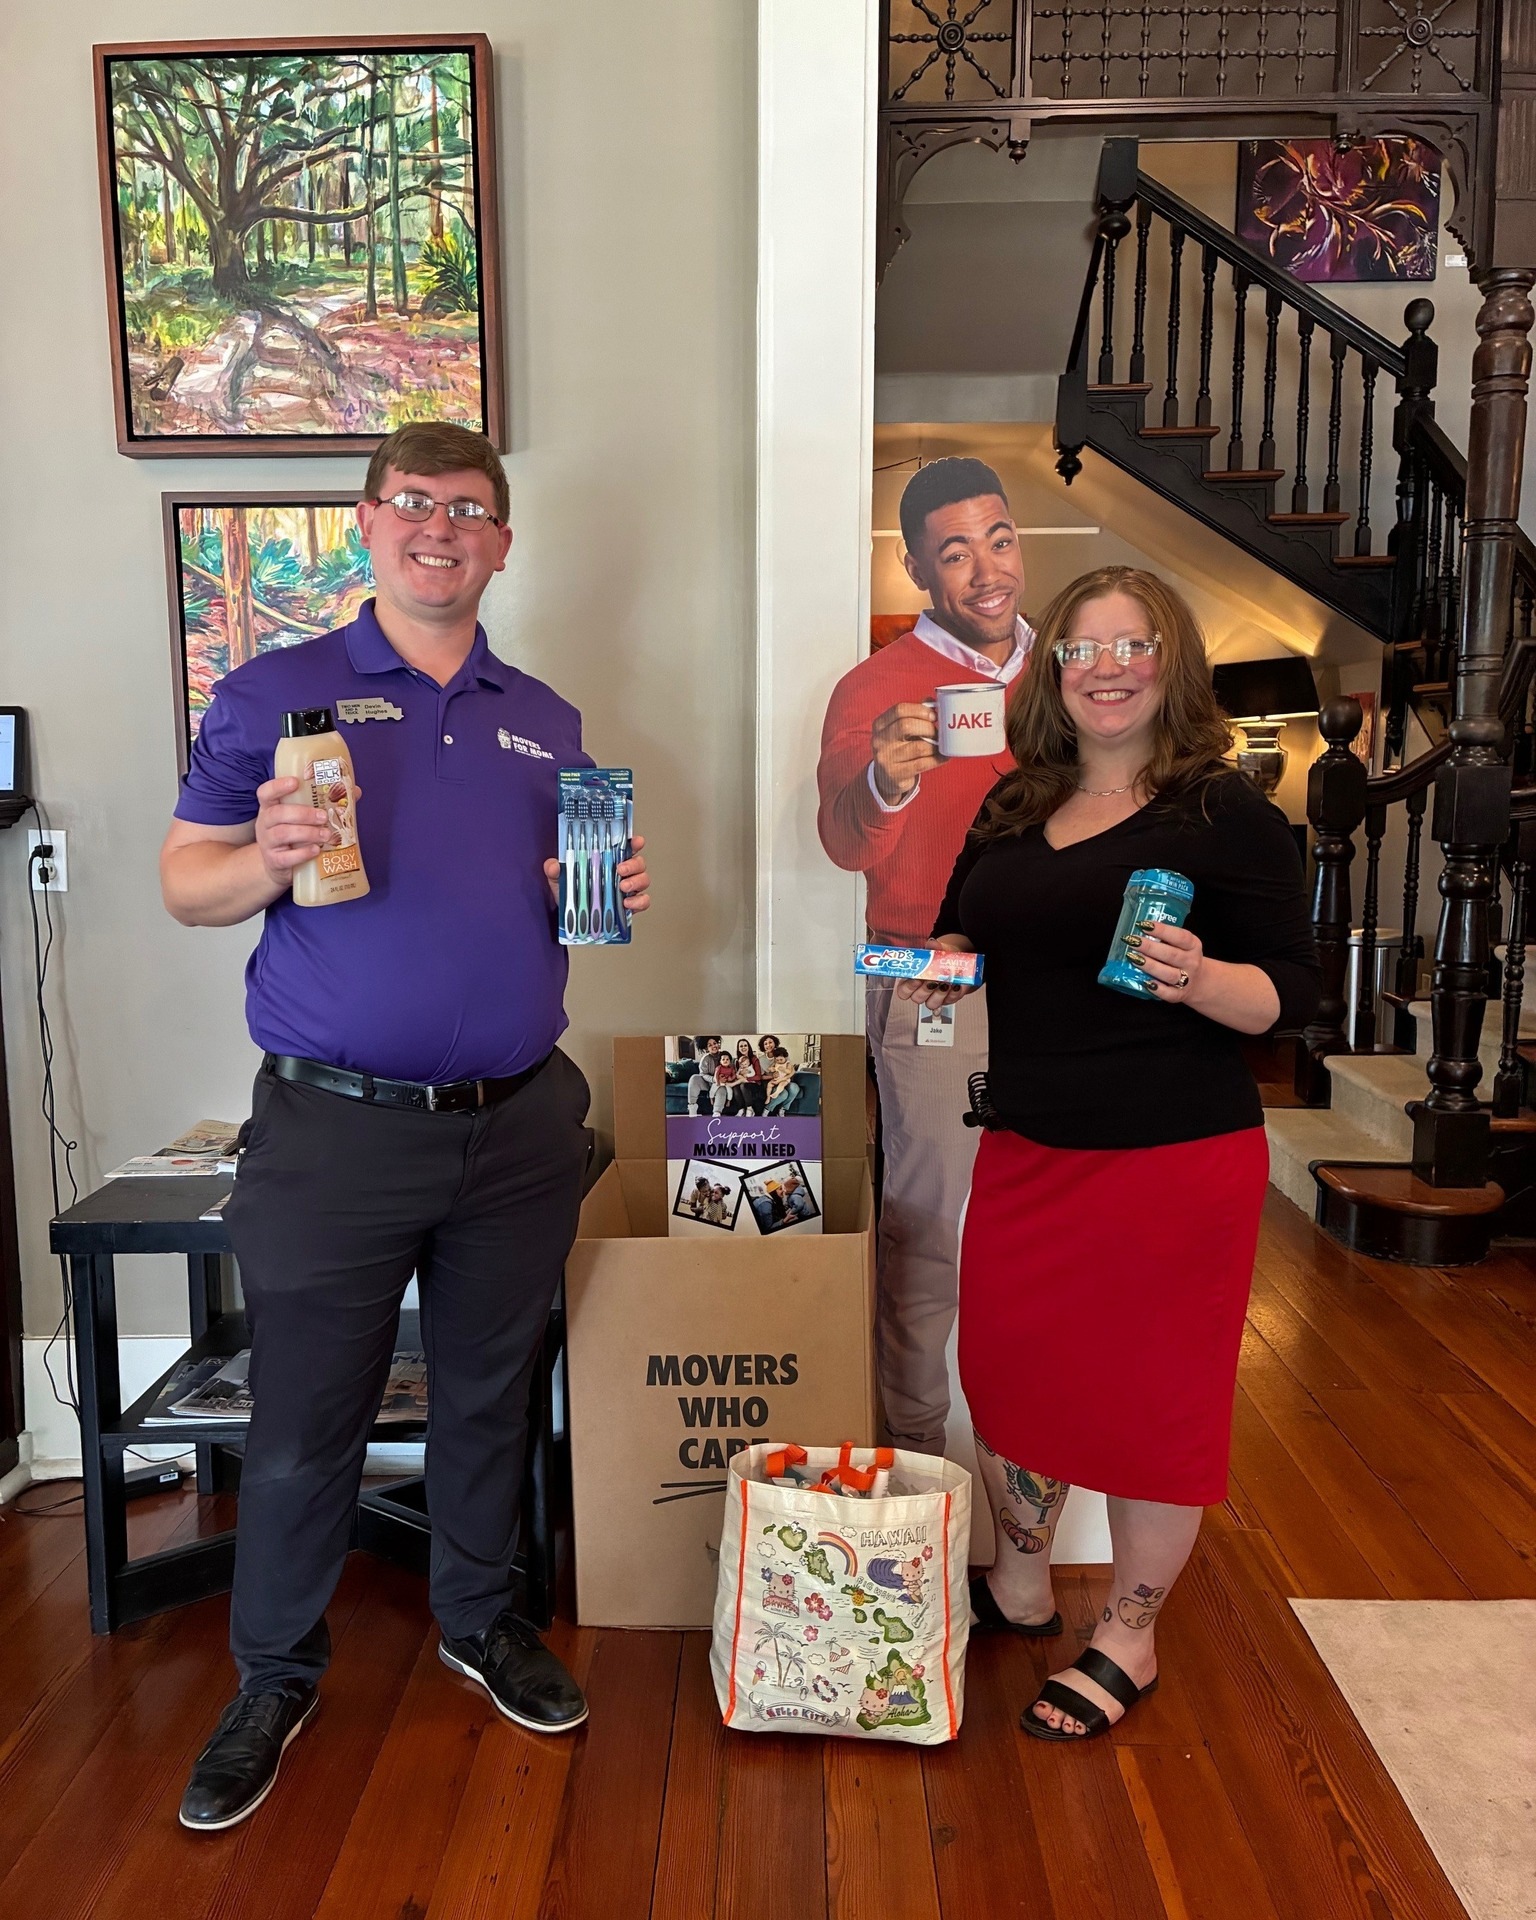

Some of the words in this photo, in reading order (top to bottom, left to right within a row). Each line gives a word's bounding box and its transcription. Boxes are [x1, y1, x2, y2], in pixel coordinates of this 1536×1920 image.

[948, 712, 993, 729] JAKE
[511, 734, 541, 750] MOVERS
[513, 742, 529, 753] FOR
[315, 760, 339, 770] PRO
[316, 769, 340, 780] SILK
[322, 852, 356, 866] BODY
[323, 860, 357, 874] WASH
[1148, 905, 1178, 924] Degree
[863, 954, 922, 970] Crest
[882, 950, 915, 960] KID'S
[940, 958, 970, 968] CAVITY
[707, 1118, 781, 1148] Support
[693, 1143, 738, 1157] MOMS
[743, 1143, 757, 1156] IN
[762, 1143, 796, 1157] NEED
[646, 1353, 799, 1386] MOVERS
[678, 1396, 769, 1428] WHO
[860, 1526, 927, 1548] HAWAII
[766, 1706, 799, 1719] HELLO
[801, 1708, 832, 1724] KITTY
[886, 1706, 919, 1719] Aloha
